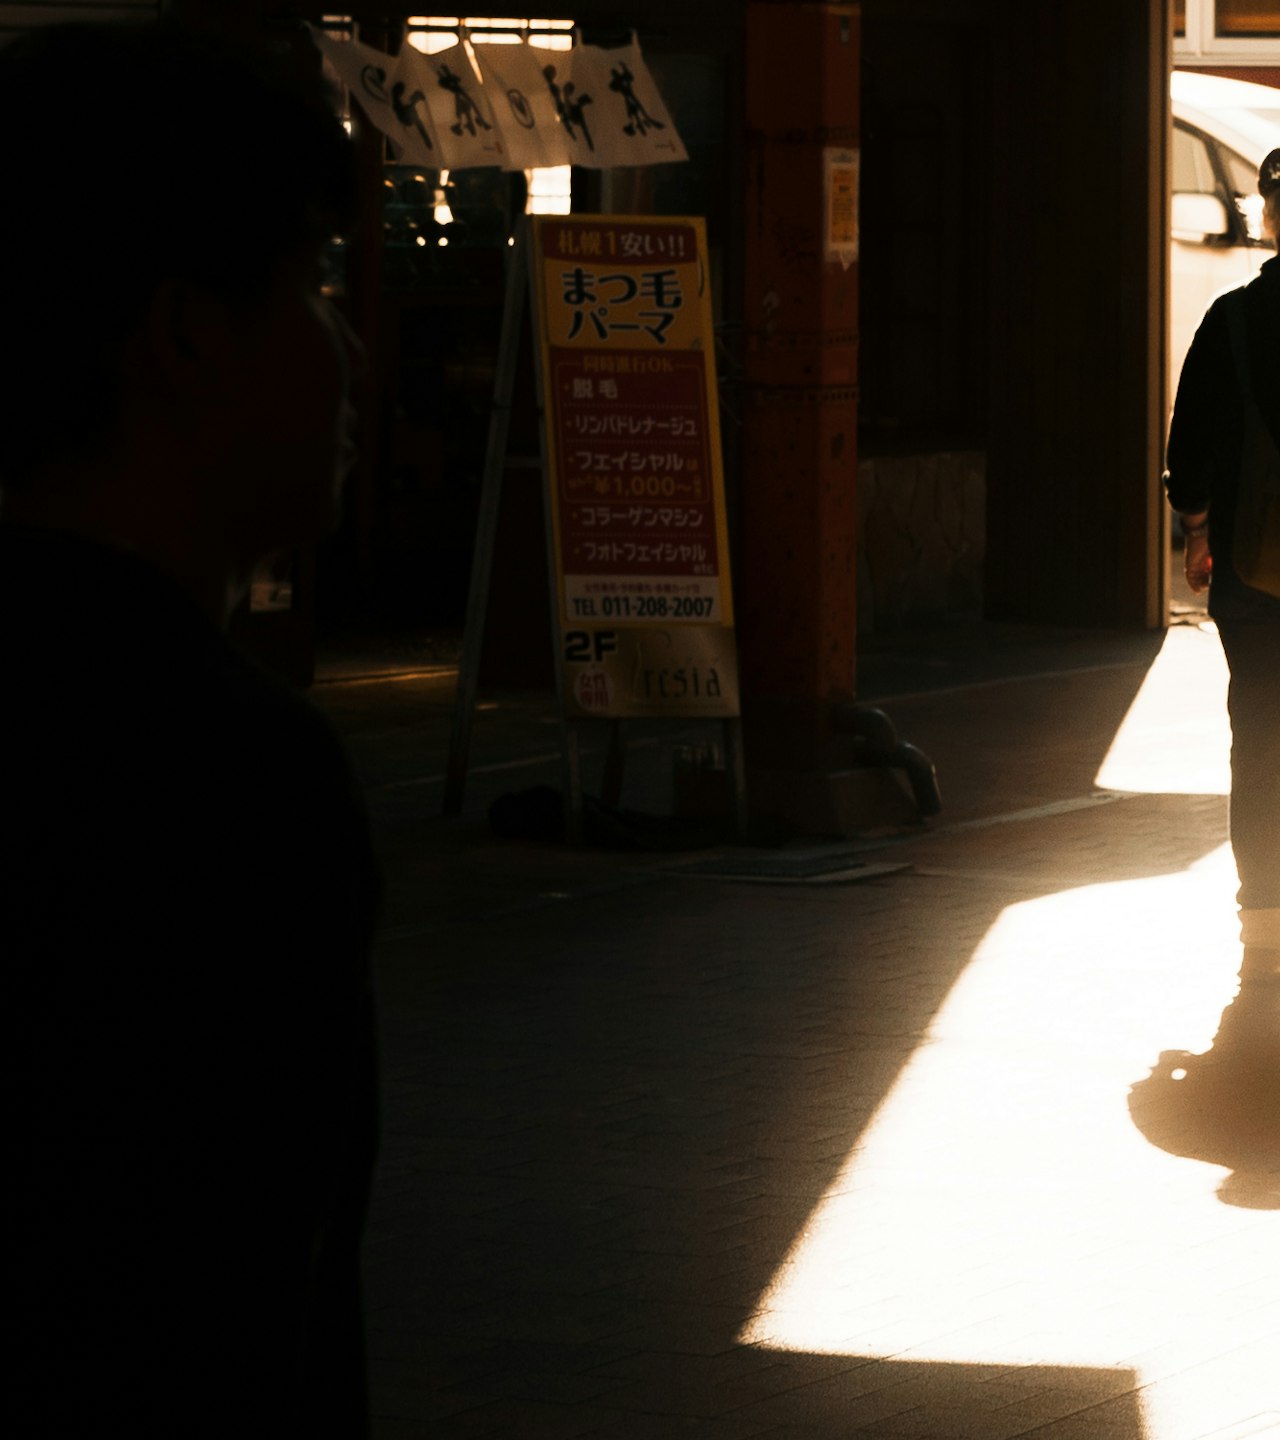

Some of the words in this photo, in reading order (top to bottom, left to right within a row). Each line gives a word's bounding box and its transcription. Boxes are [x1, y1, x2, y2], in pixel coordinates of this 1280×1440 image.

[560, 267, 683, 309] まつ毛
[567, 306, 675, 345] パーマ
[580, 507, 704, 528] コラーゲンマシン
[583, 541, 707, 563] フォトフェイシャル
[574, 598, 597, 616] TEL
[602, 596, 713, 618] 011-208-2007
[565, 631, 617, 662] 2F
